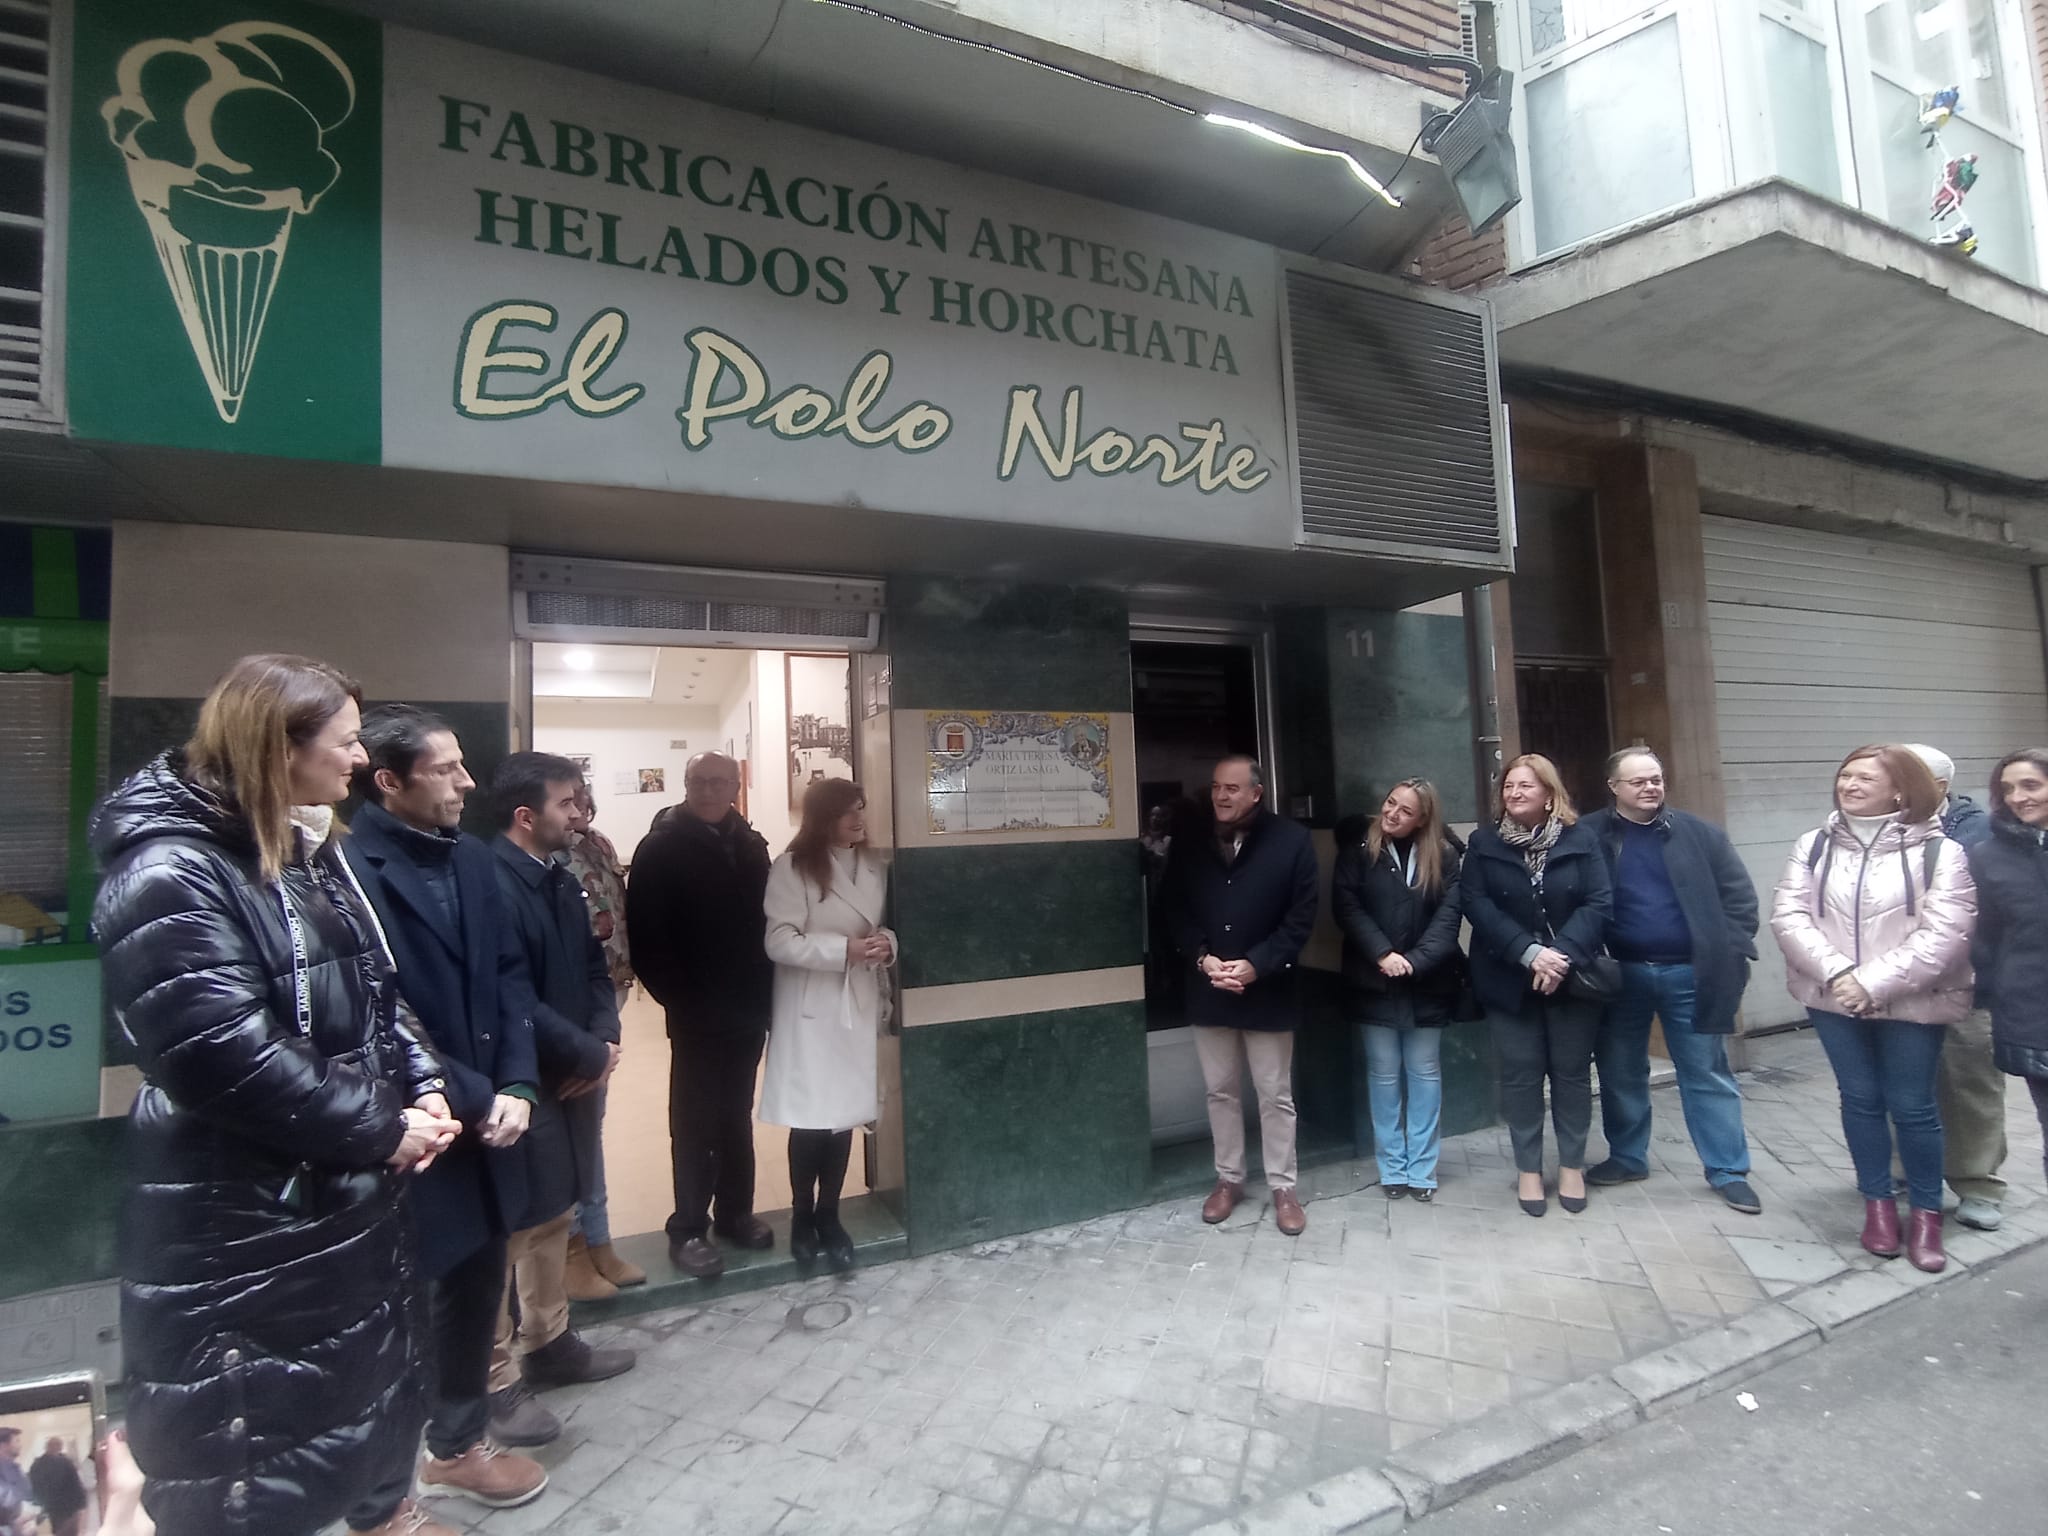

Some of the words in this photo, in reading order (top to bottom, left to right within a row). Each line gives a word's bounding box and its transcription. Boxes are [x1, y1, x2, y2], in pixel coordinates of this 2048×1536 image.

[438, 95, 950, 253] FABRICACIÓN
[968, 217, 1254, 318] ARTESANA
[474, 188, 849, 305] HELADOS
[868, 266, 911, 315] Y
[929, 276, 1240, 375] HORCHATA
[453, 299, 646, 420] El
[677, 326, 953, 455] Polo
[998, 384, 1271, 494] Norte
[1345, 629, 1375, 657] 11
